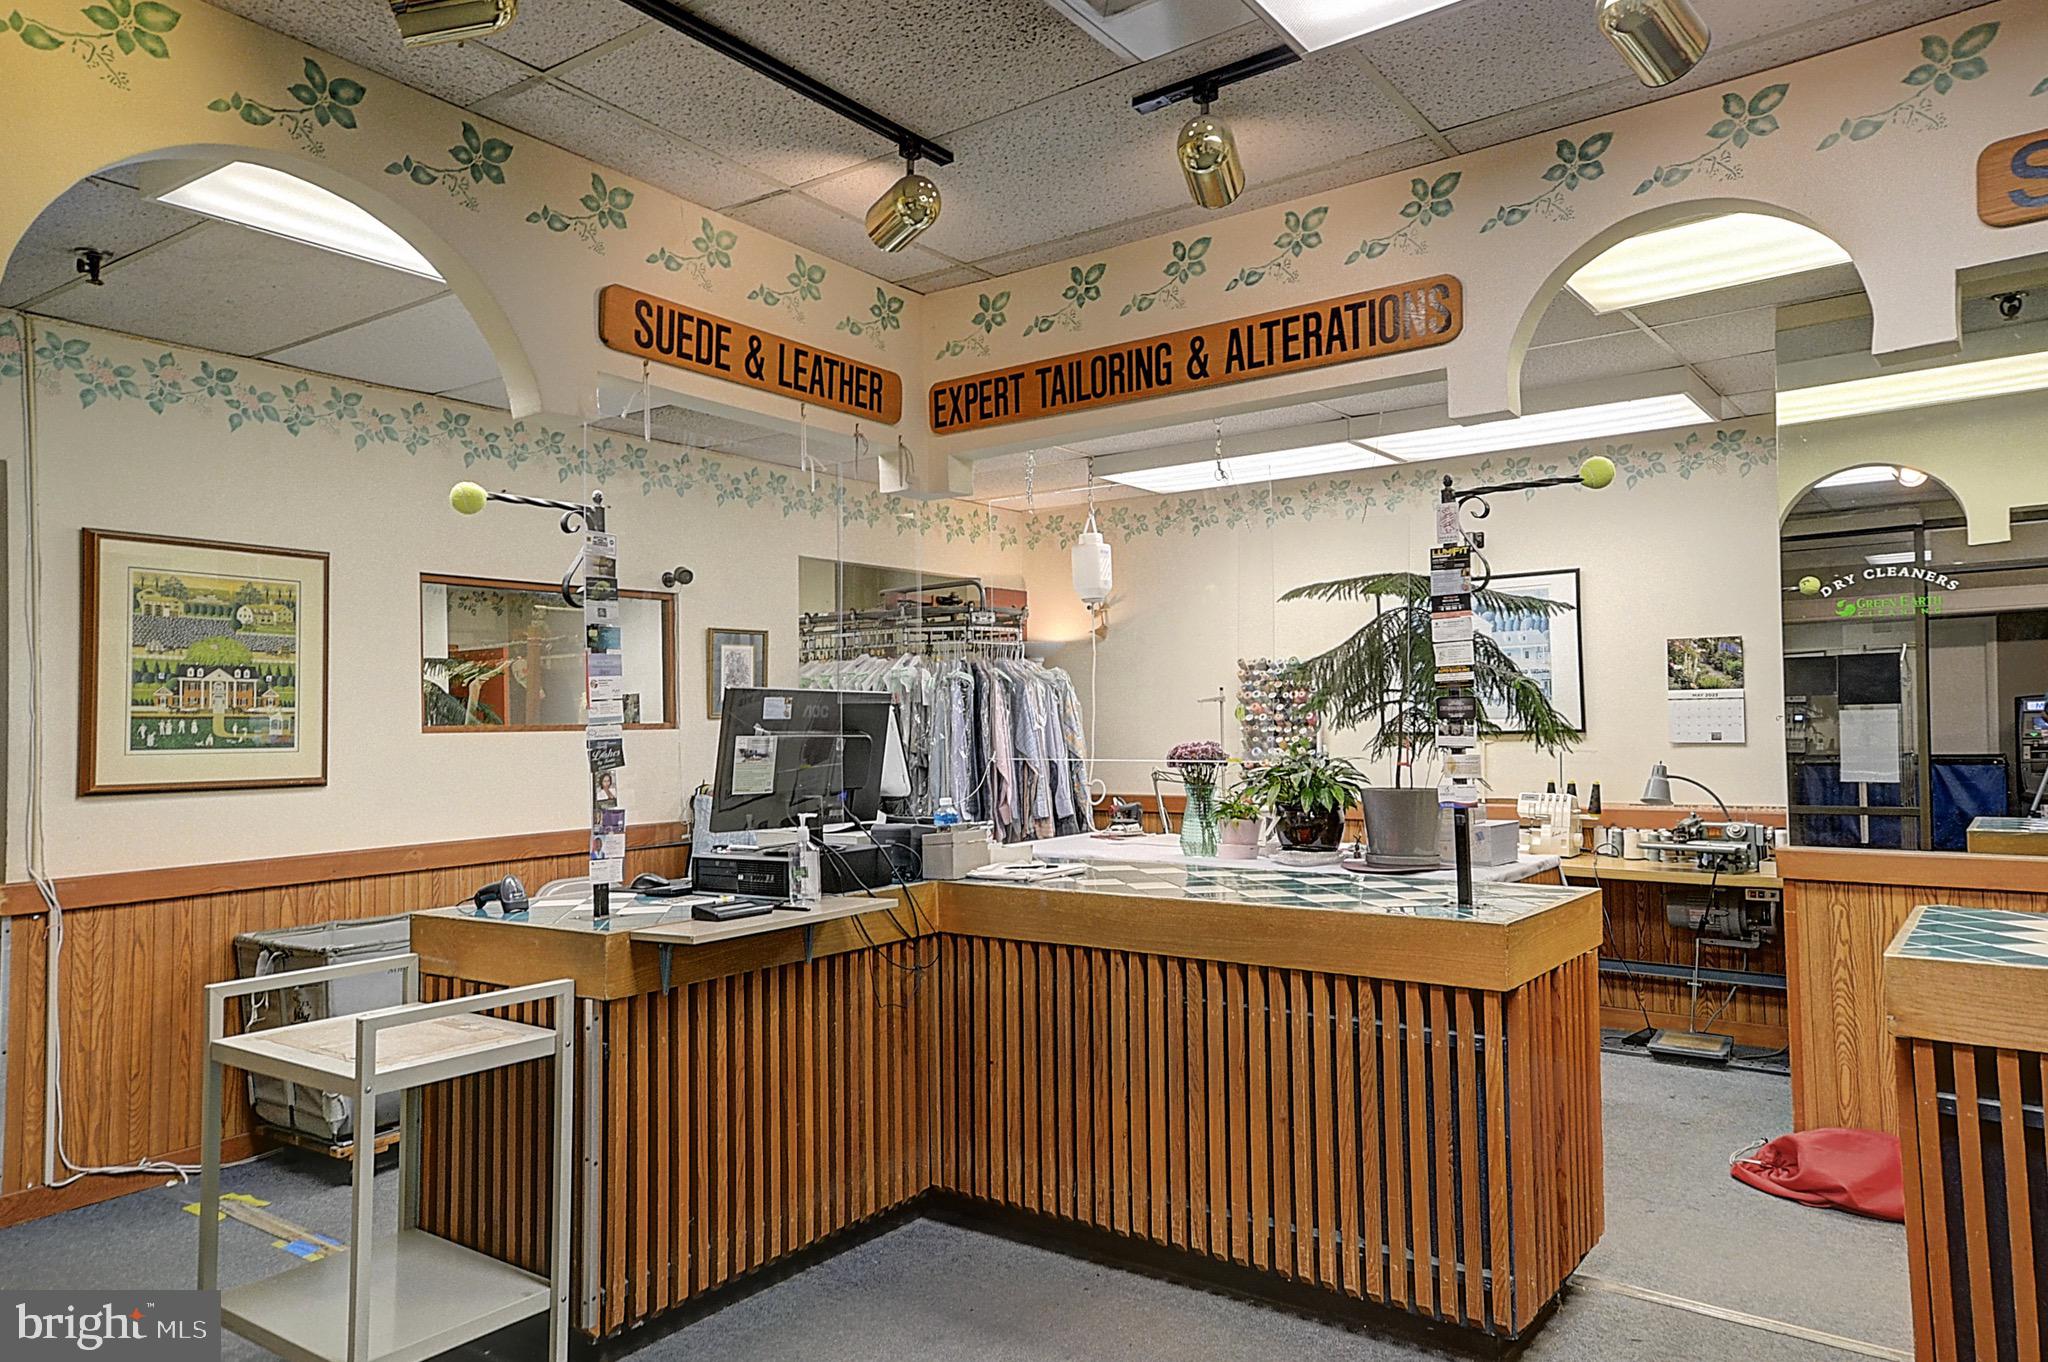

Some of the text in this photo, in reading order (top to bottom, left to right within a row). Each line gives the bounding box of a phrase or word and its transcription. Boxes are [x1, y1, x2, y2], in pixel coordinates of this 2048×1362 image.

[633, 299, 883, 414] SUEDE & LEATHER
[934, 283, 1452, 430] EXPERT TAILORING & ALTERATIONS
[1820, 566, 1960, 598] DRY CLEANERS
[802, 704, 829, 719] AOC
